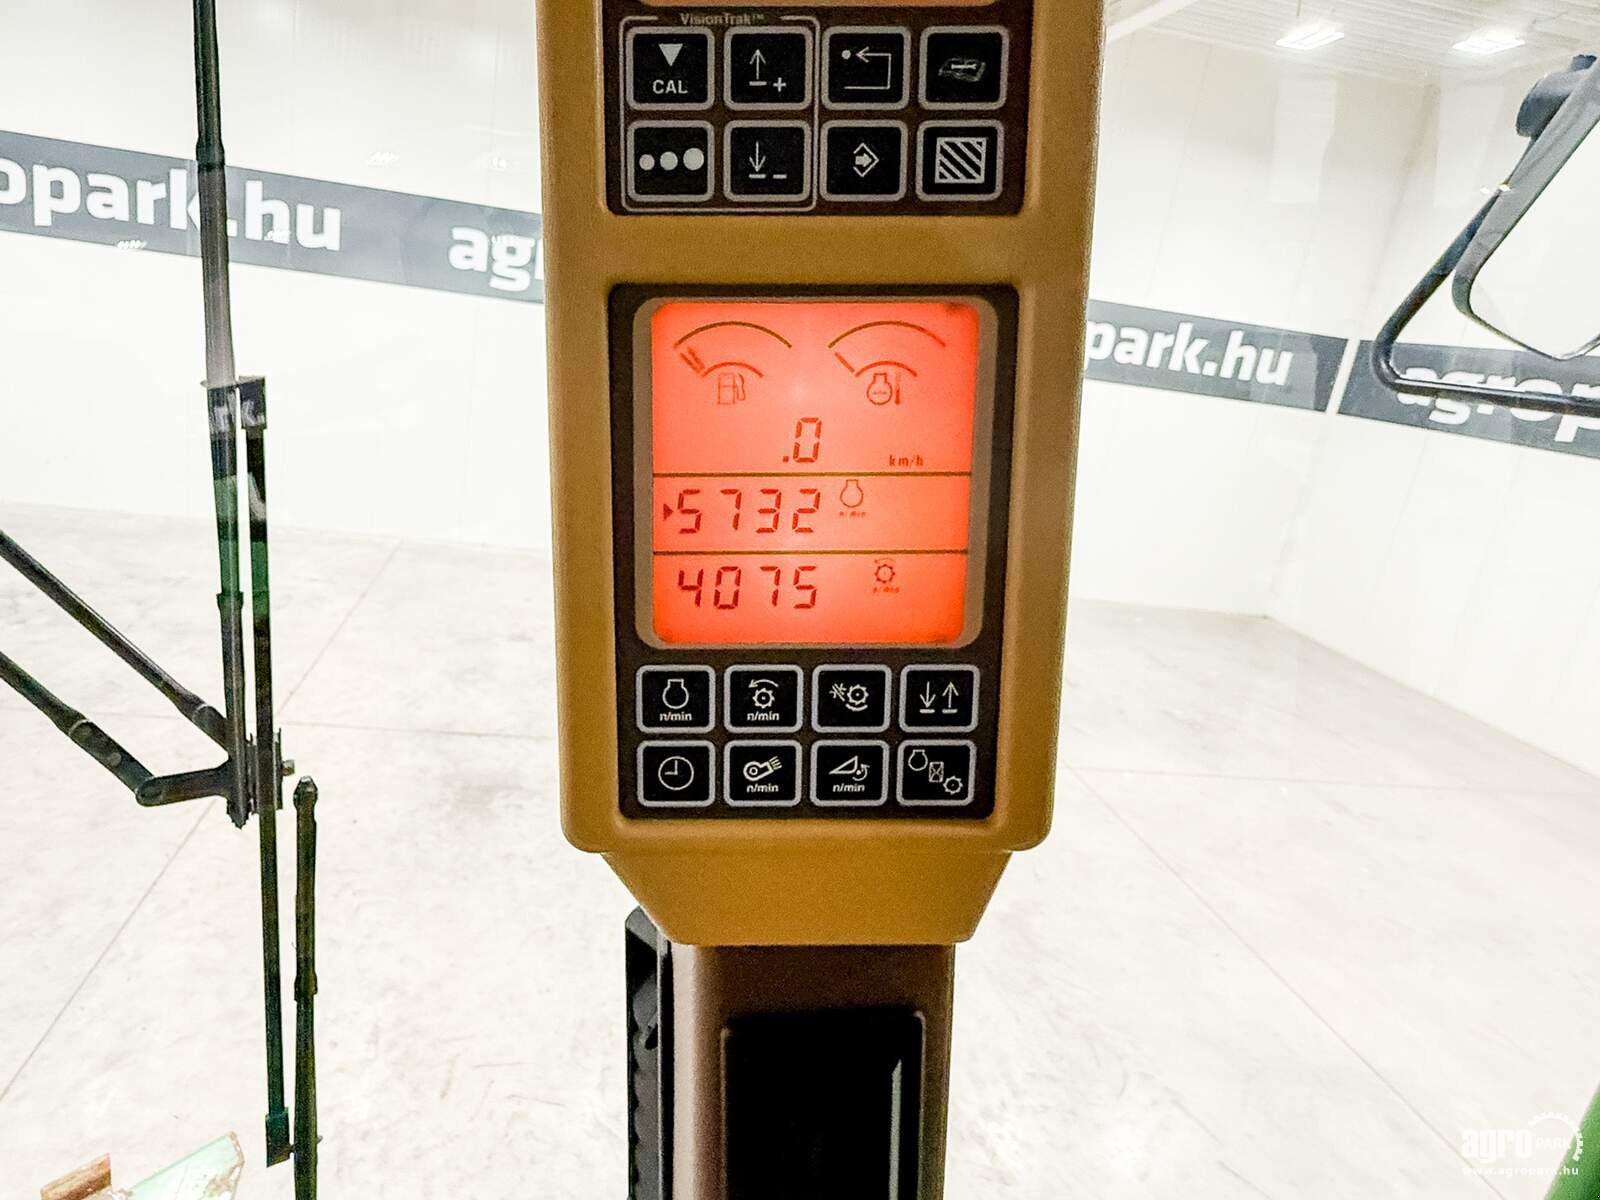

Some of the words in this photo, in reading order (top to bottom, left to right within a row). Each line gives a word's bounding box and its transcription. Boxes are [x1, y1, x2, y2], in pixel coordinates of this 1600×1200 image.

[652, 79, 688, 95] CAL
[677, 488, 821, 534] 5732
[678, 565, 818, 610] 4075
[659, 711, 693, 721] n/min
[747, 711, 780, 721] n/min
[746, 783, 779, 793] n/min
[832, 783, 865, 793] n/min
